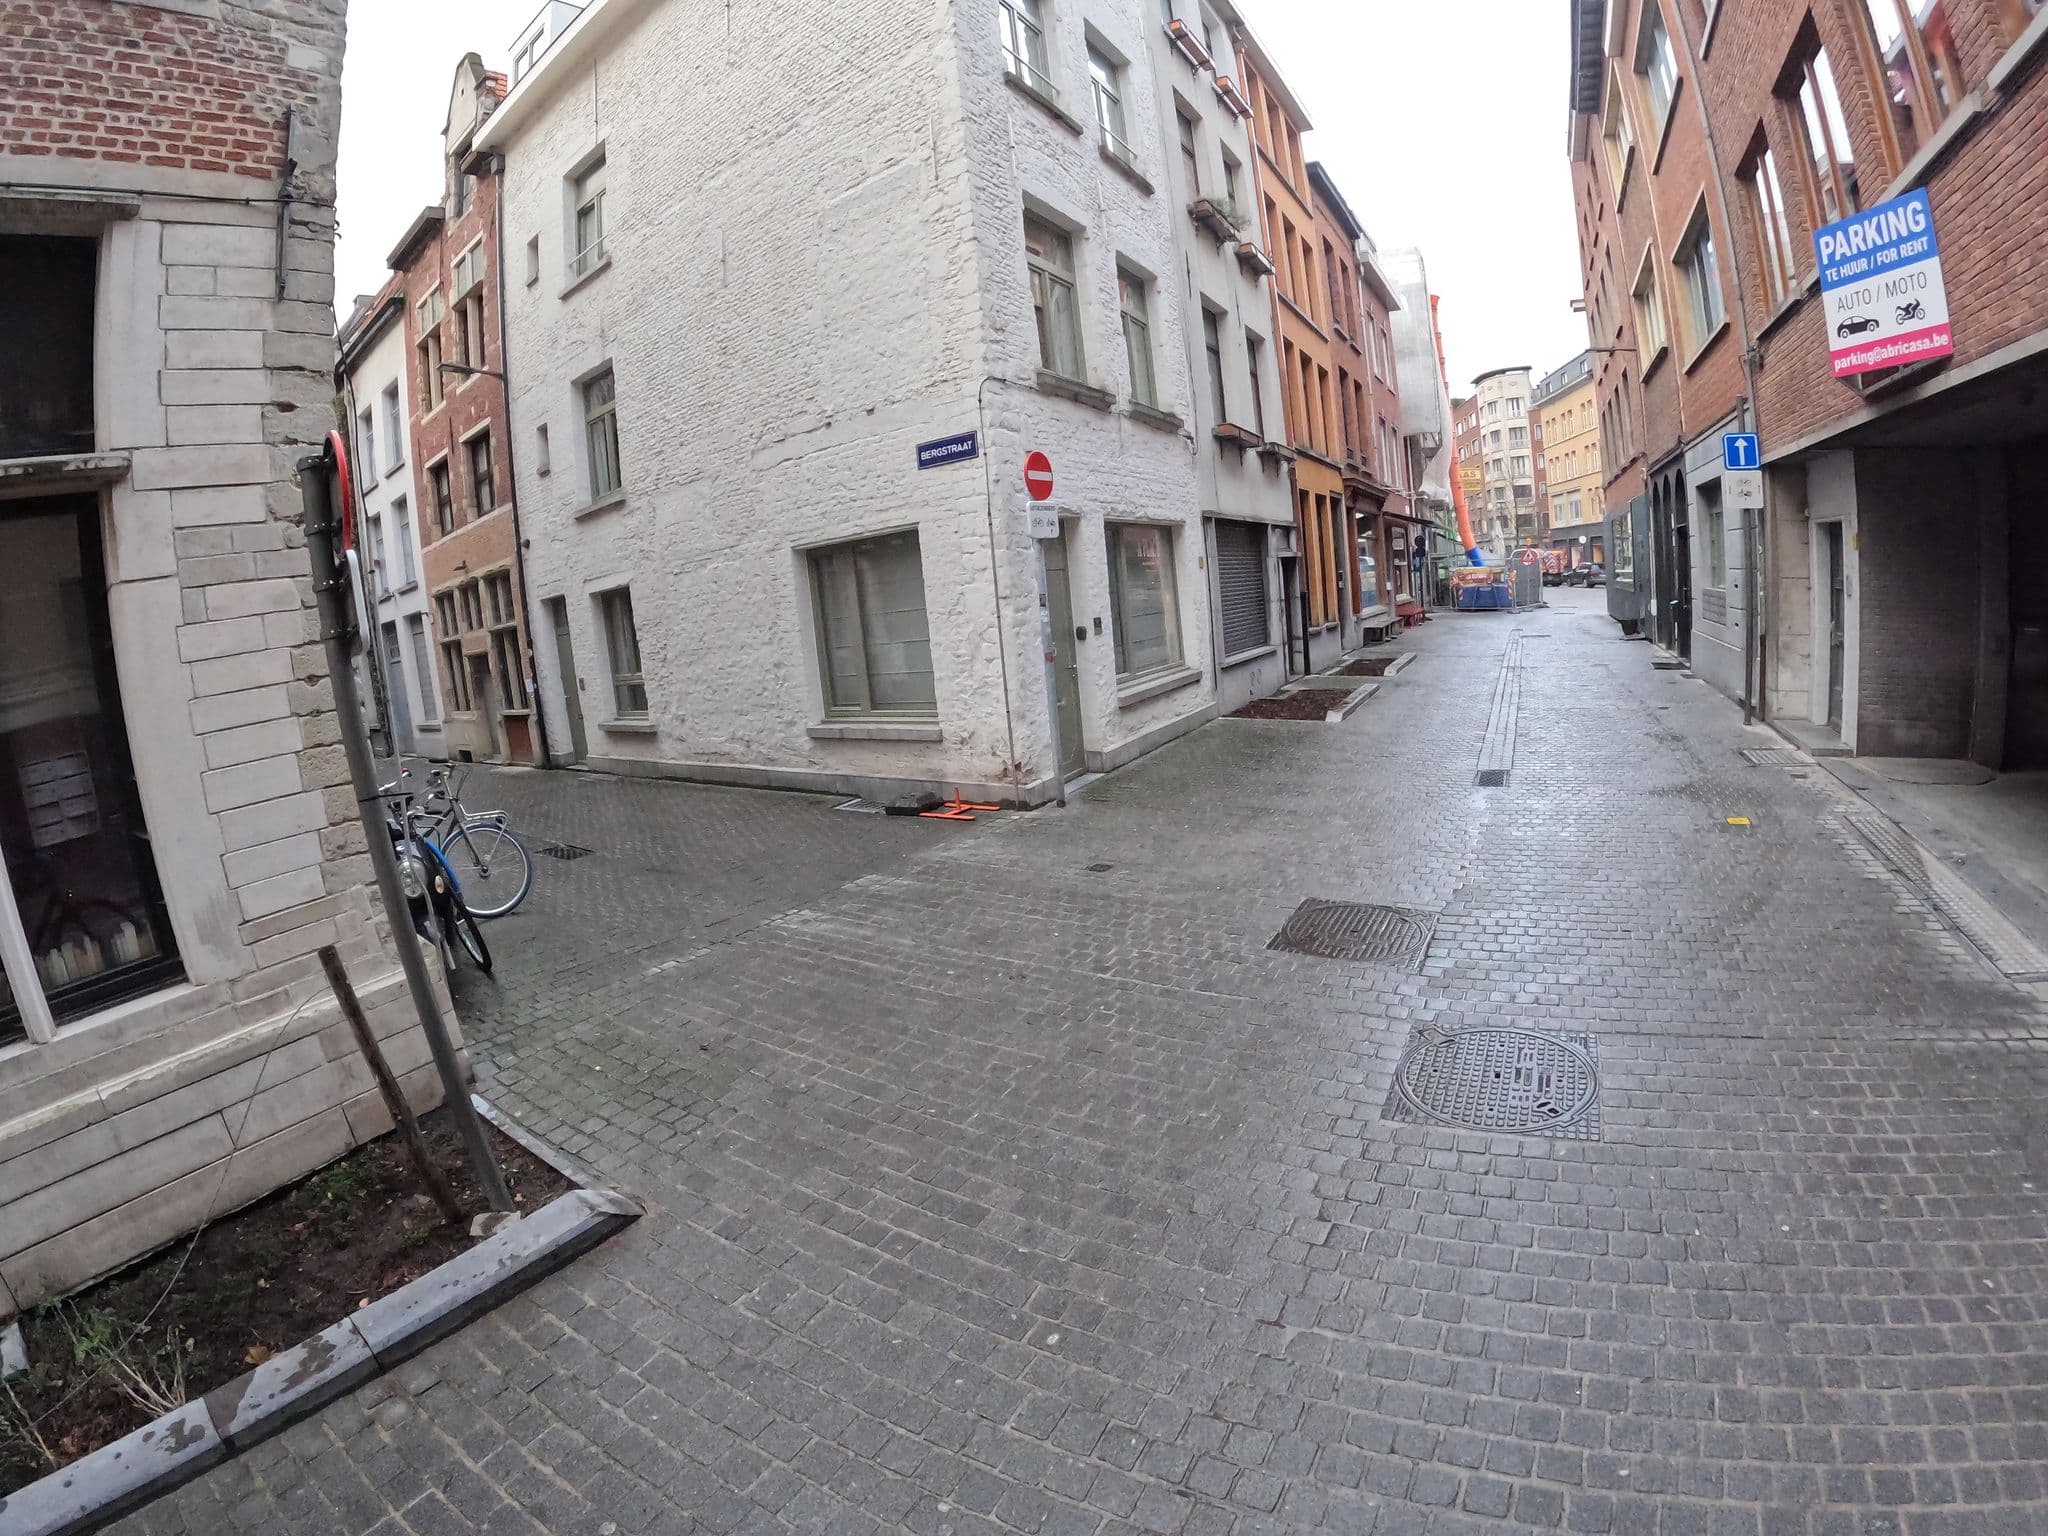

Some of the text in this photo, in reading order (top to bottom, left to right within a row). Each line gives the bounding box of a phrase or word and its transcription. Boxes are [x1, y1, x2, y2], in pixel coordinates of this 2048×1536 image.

[1819, 201, 1926, 265] PARKING
[1825, 237, 1929, 282] TE HUUR / FOR RENT
[1837, 271, 1927, 313] AUTO / MOTO
[1834, 332, 1949, 372] parking@abricasa.be
[920, 441, 973, 460] BERGSTRAAT
